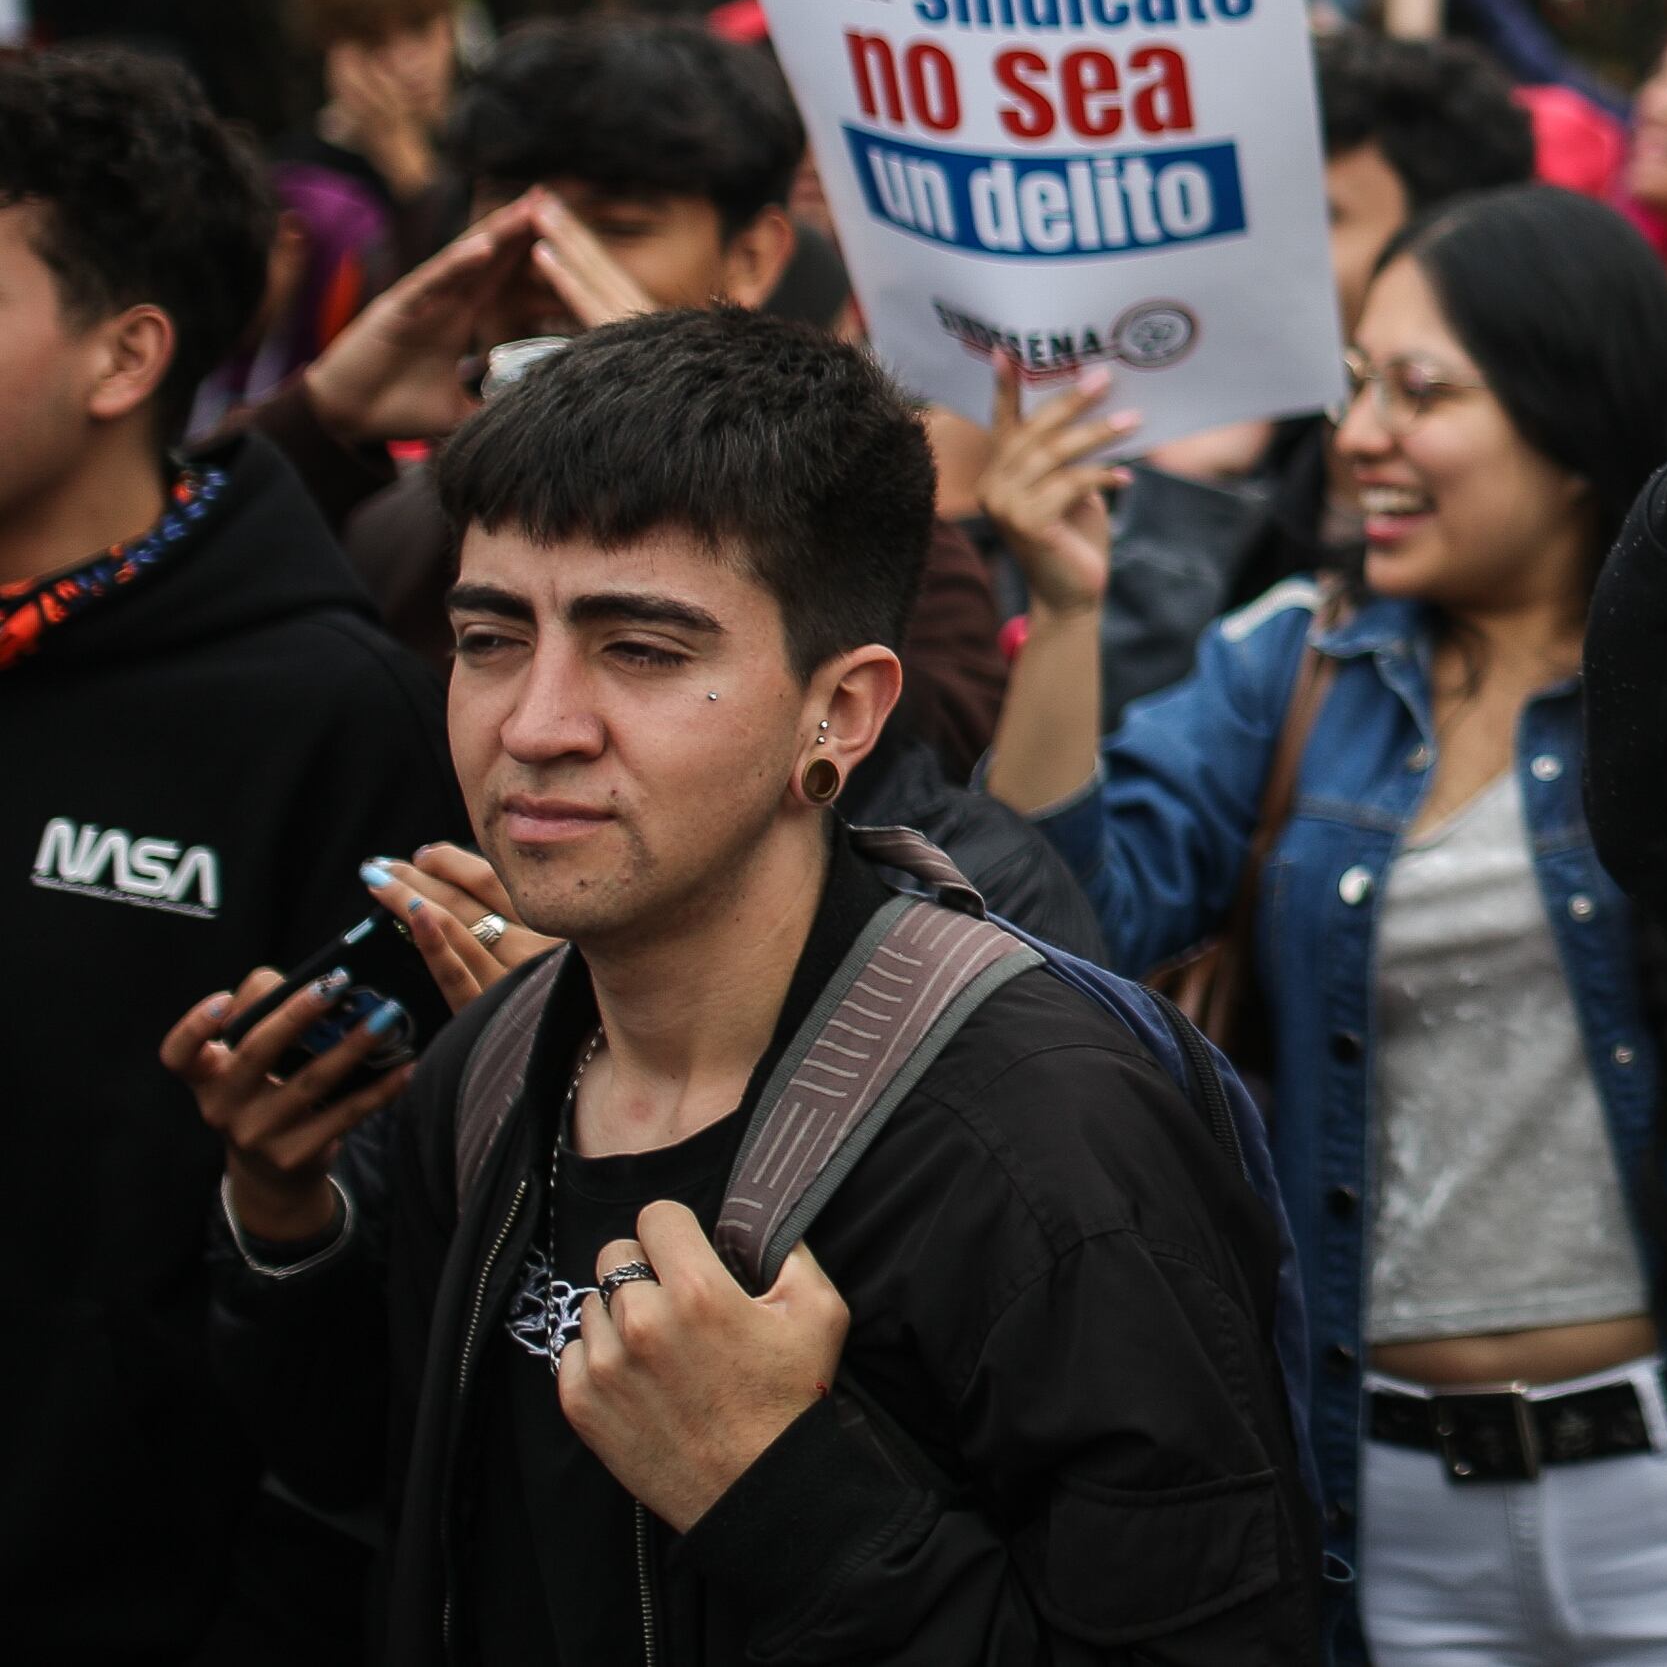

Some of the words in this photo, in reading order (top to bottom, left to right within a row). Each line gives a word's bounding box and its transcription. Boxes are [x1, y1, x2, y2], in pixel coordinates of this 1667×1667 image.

[847, 32, 959, 131] no
[994, 45, 1193, 139] sea
[870, 149, 959, 242] un
[974, 156, 1211, 252] delito
[34, 817, 220, 908] NASA
